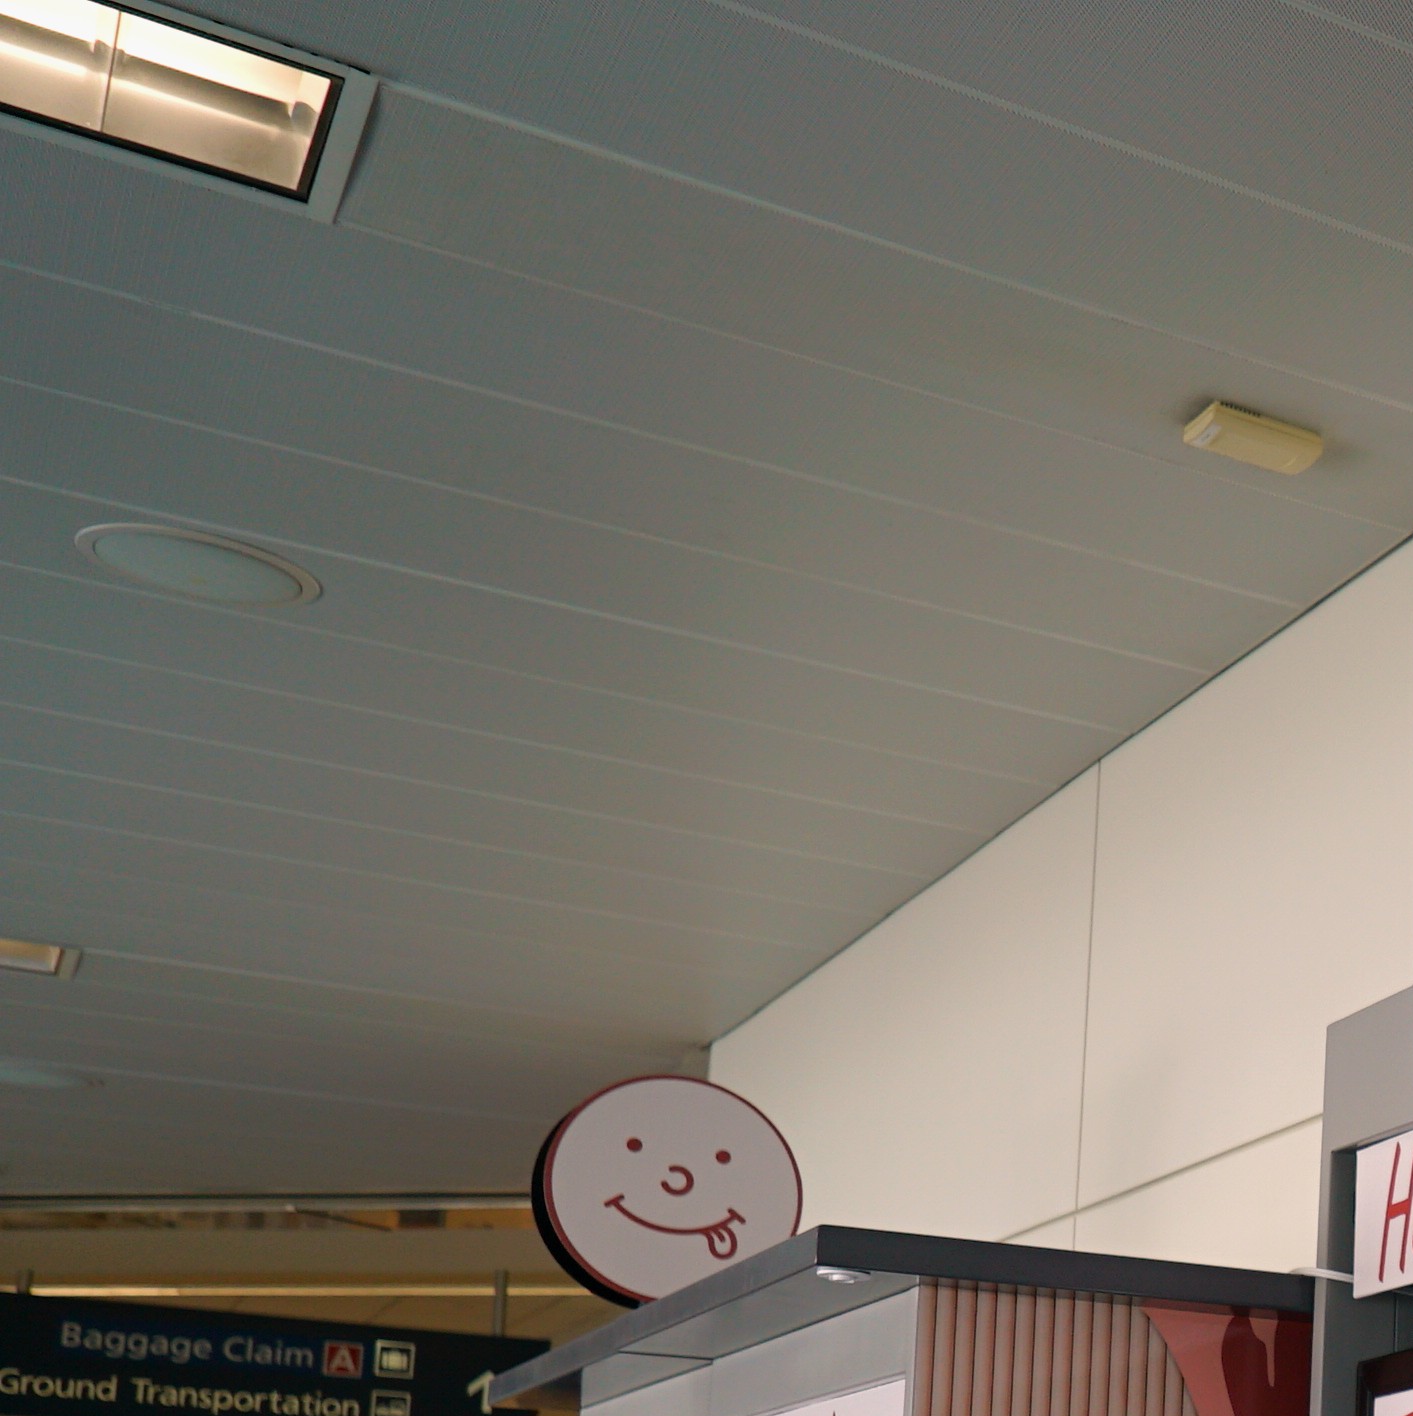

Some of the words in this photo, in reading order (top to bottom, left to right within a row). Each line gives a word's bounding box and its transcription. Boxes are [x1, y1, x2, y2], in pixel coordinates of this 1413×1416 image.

[61, 1320, 211, 1364] Baggage
[223, 1335, 314, 1367] Claim
[326, 1344, 357, 1373] A
[0, 1367, 118, 1402] Ground
